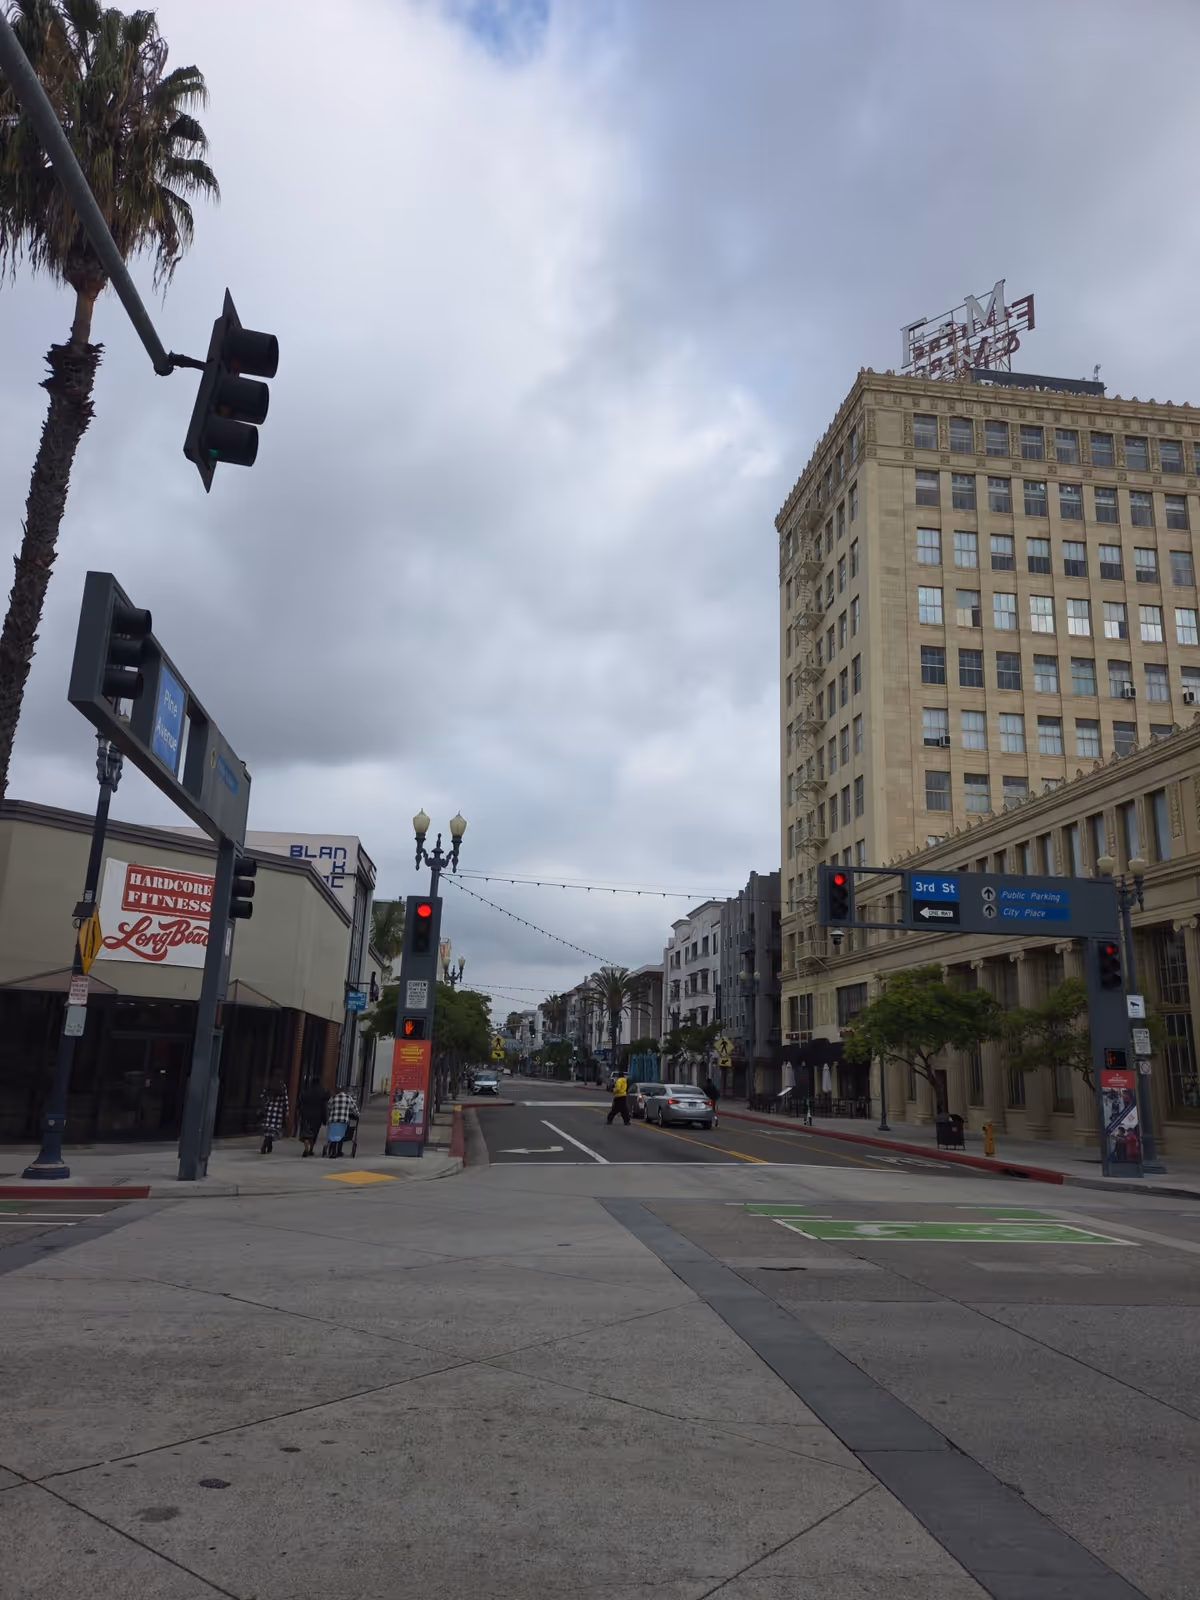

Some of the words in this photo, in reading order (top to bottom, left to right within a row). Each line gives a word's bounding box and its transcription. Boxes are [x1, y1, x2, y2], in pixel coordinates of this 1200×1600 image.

[163, 689, 178, 717] Pine
[155, 717, 178, 752] Avenue
[290, 845, 347, 859] BLAN
[129, 872, 213, 897] HARDCORE
[915, 882, 935, 893] 3rd
[942, 882, 956, 894] St
[127, 890, 212, 913] FITNESS
[1002, 890, 1025, 900] Public
[1030, 891, 1061, 903] Parking
[1003, 907, 1020, 918] City
[1024, 908, 1046, 918] Place
[102, 915, 173, 962] Long
[158, 919, 209, 947] Beac
